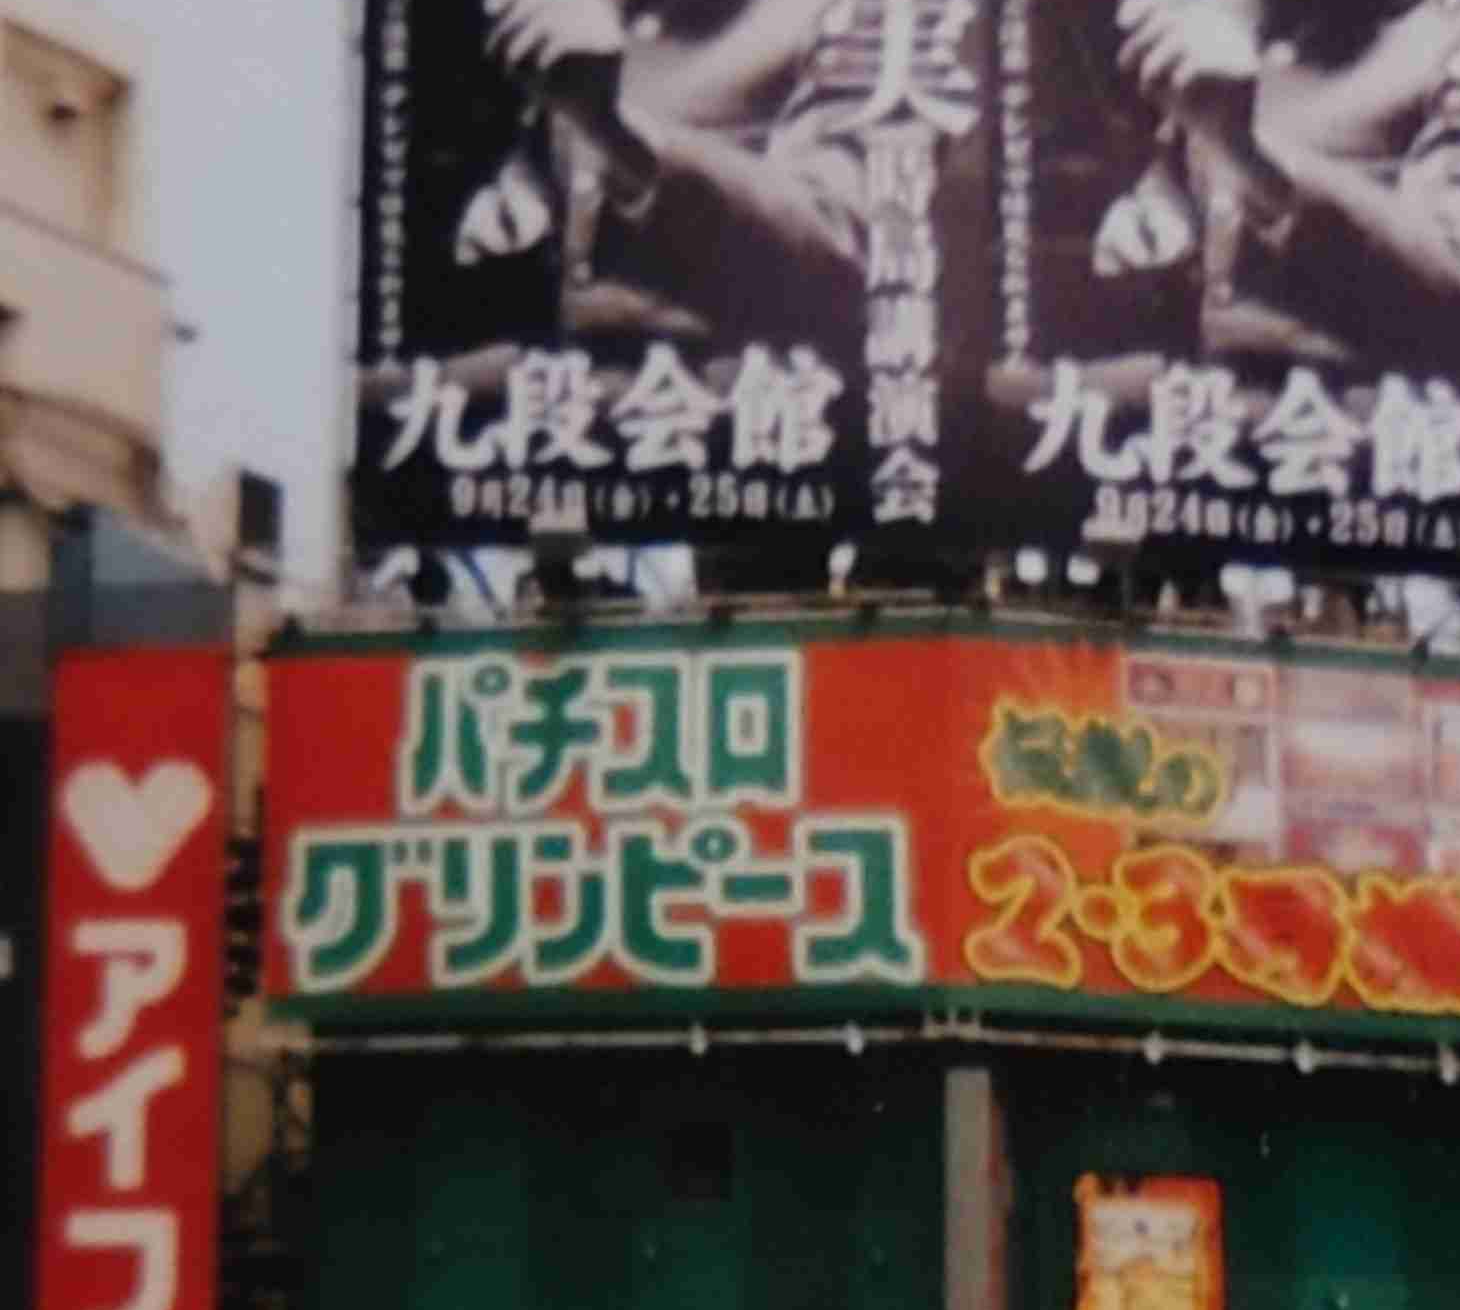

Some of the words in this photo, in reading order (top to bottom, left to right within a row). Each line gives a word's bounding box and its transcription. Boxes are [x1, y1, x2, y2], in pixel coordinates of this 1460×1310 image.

[380, 339, 844, 472] 九段会館
[395, 648, 806, 818] パチスロ
[280, 808, 927, 992] グリンピース
